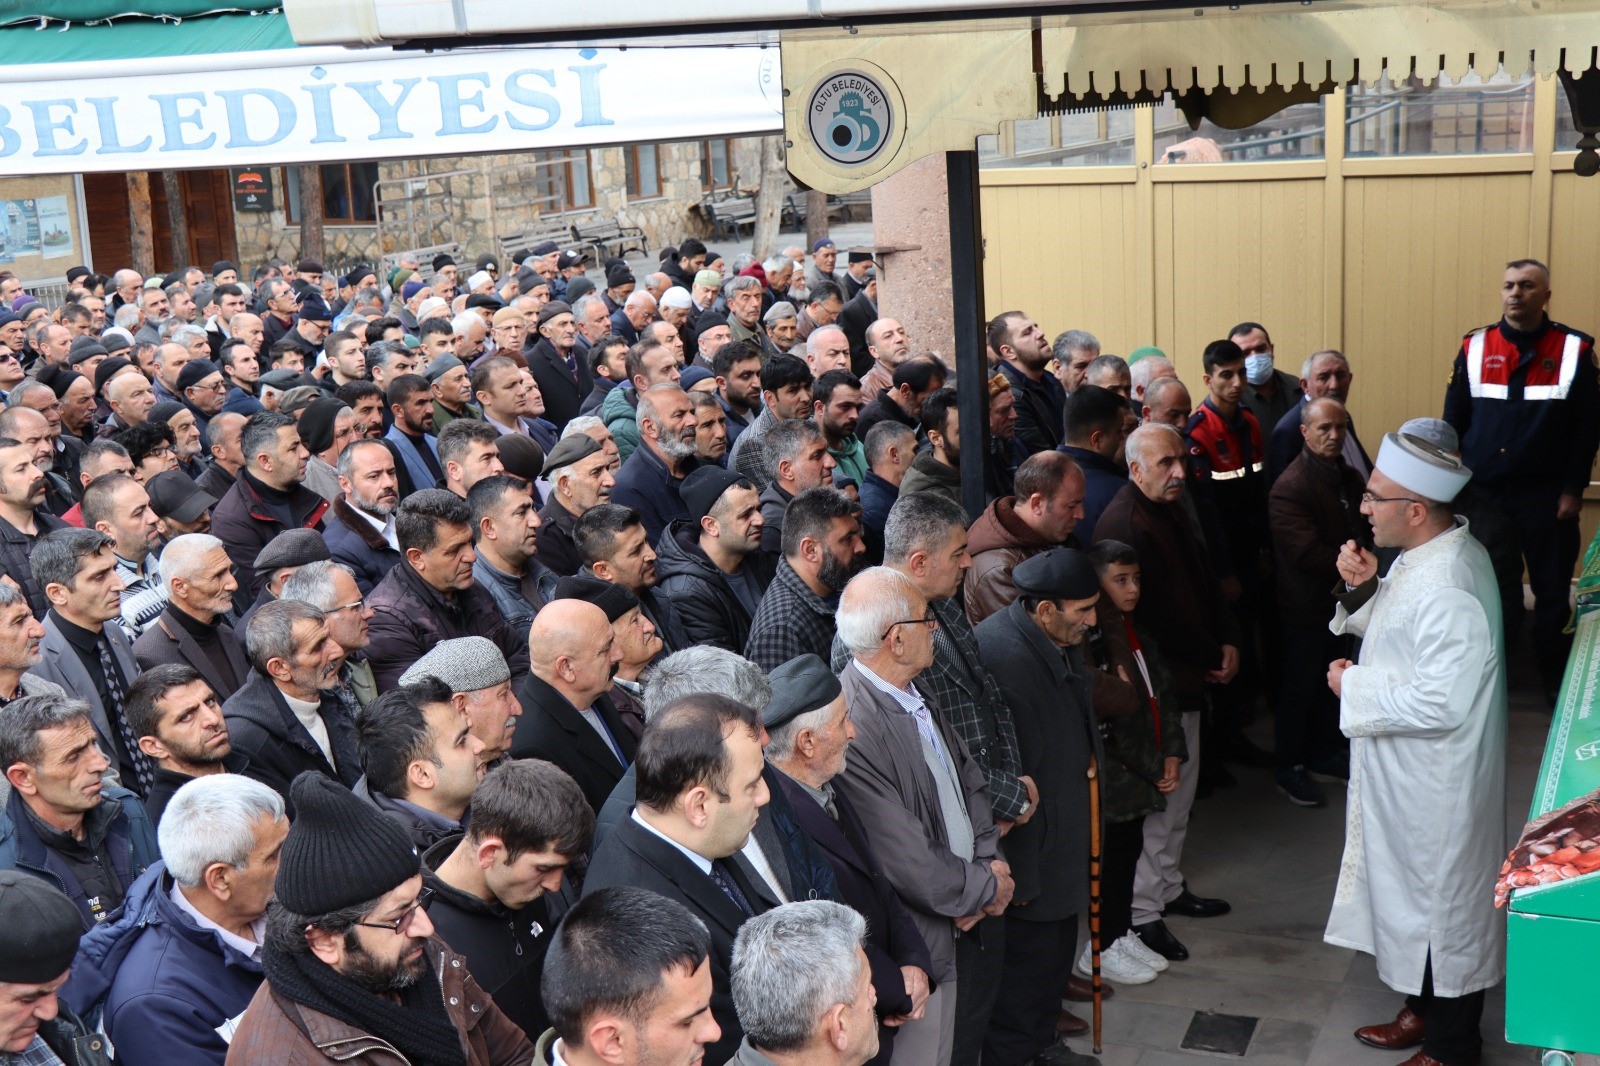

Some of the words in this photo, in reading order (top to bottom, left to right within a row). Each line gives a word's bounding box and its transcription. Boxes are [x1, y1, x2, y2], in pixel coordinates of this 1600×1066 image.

[815, 88, 832, 112] OLTU
[831, 79, 882, 106] BELEDİYESİ
[841, 99, 859, 108] 1923
